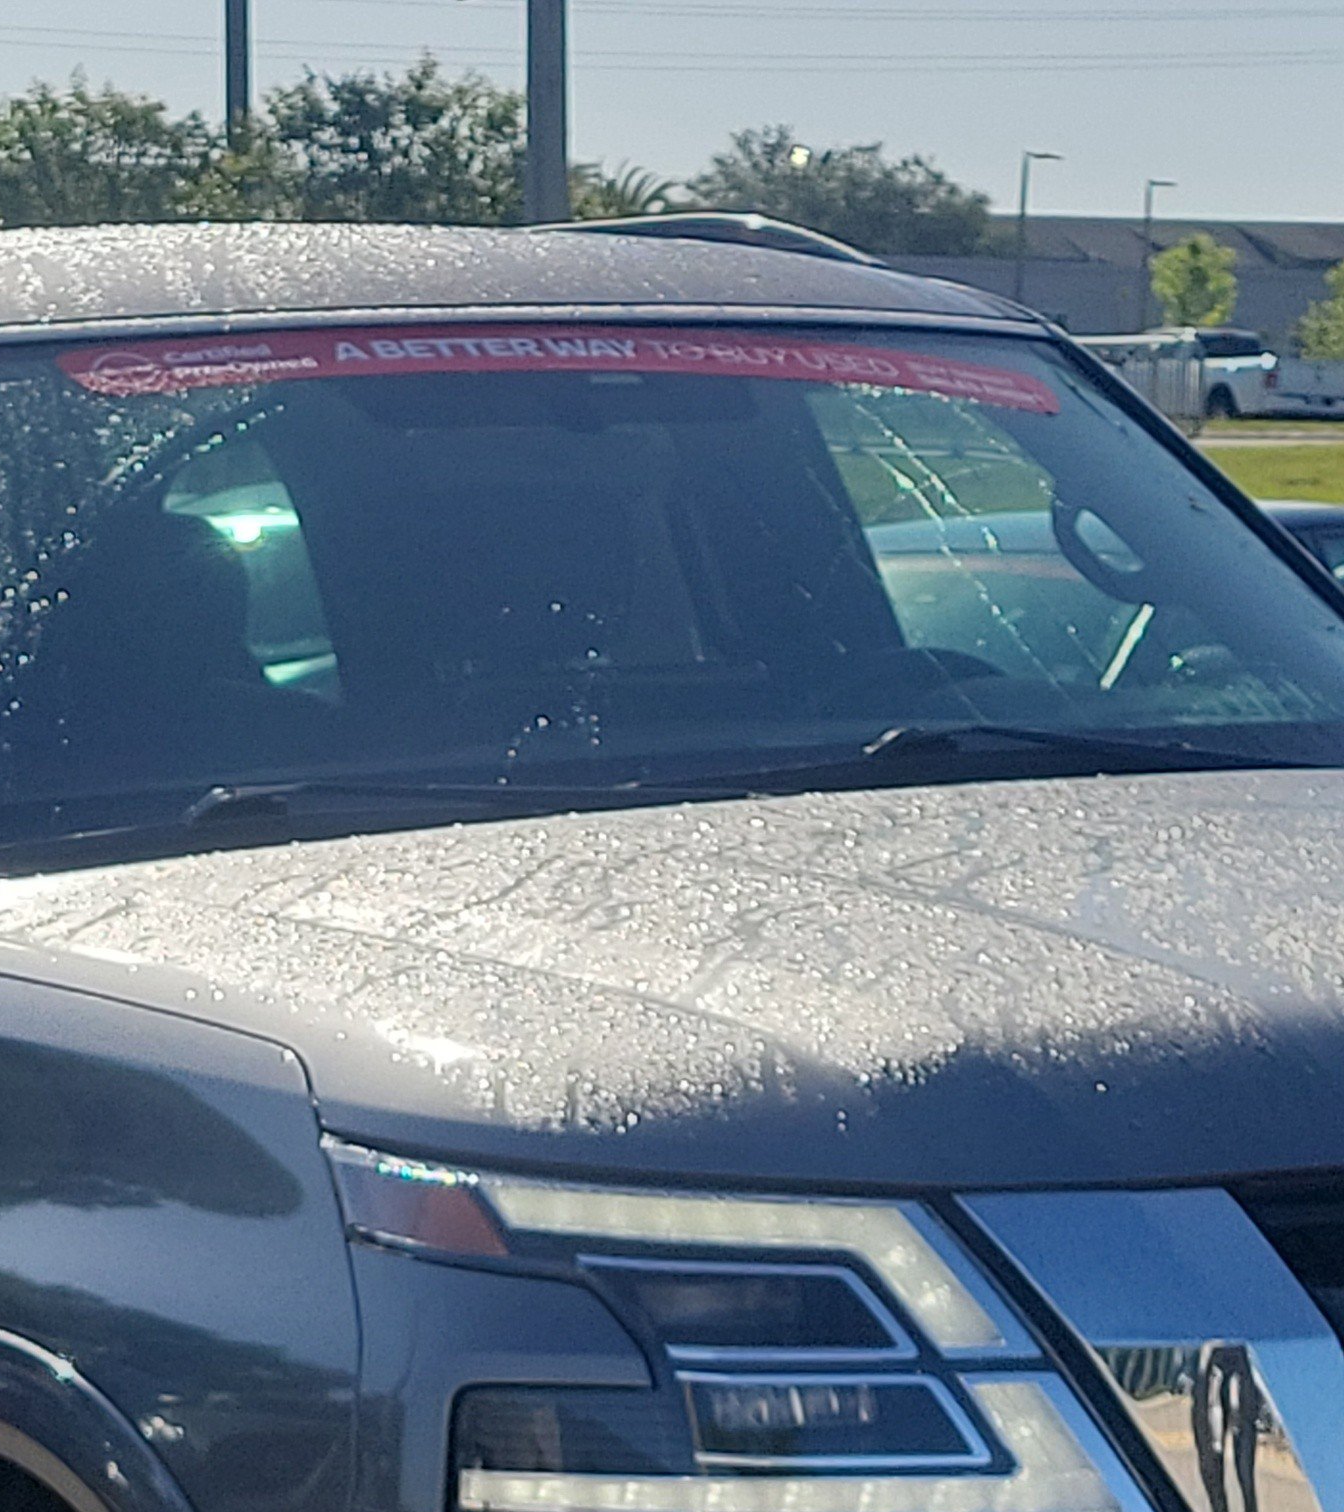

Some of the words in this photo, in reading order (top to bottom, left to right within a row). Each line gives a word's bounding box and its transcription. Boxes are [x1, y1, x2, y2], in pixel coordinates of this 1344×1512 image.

[334, 341, 368, 362] A
[369, 337, 543, 360] BETTER
[543, 337, 636, 359] WAY
[642, 340, 705, 361] TO
[706, 342, 787, 366] BUY
[789, 349, 901, 377] USED
